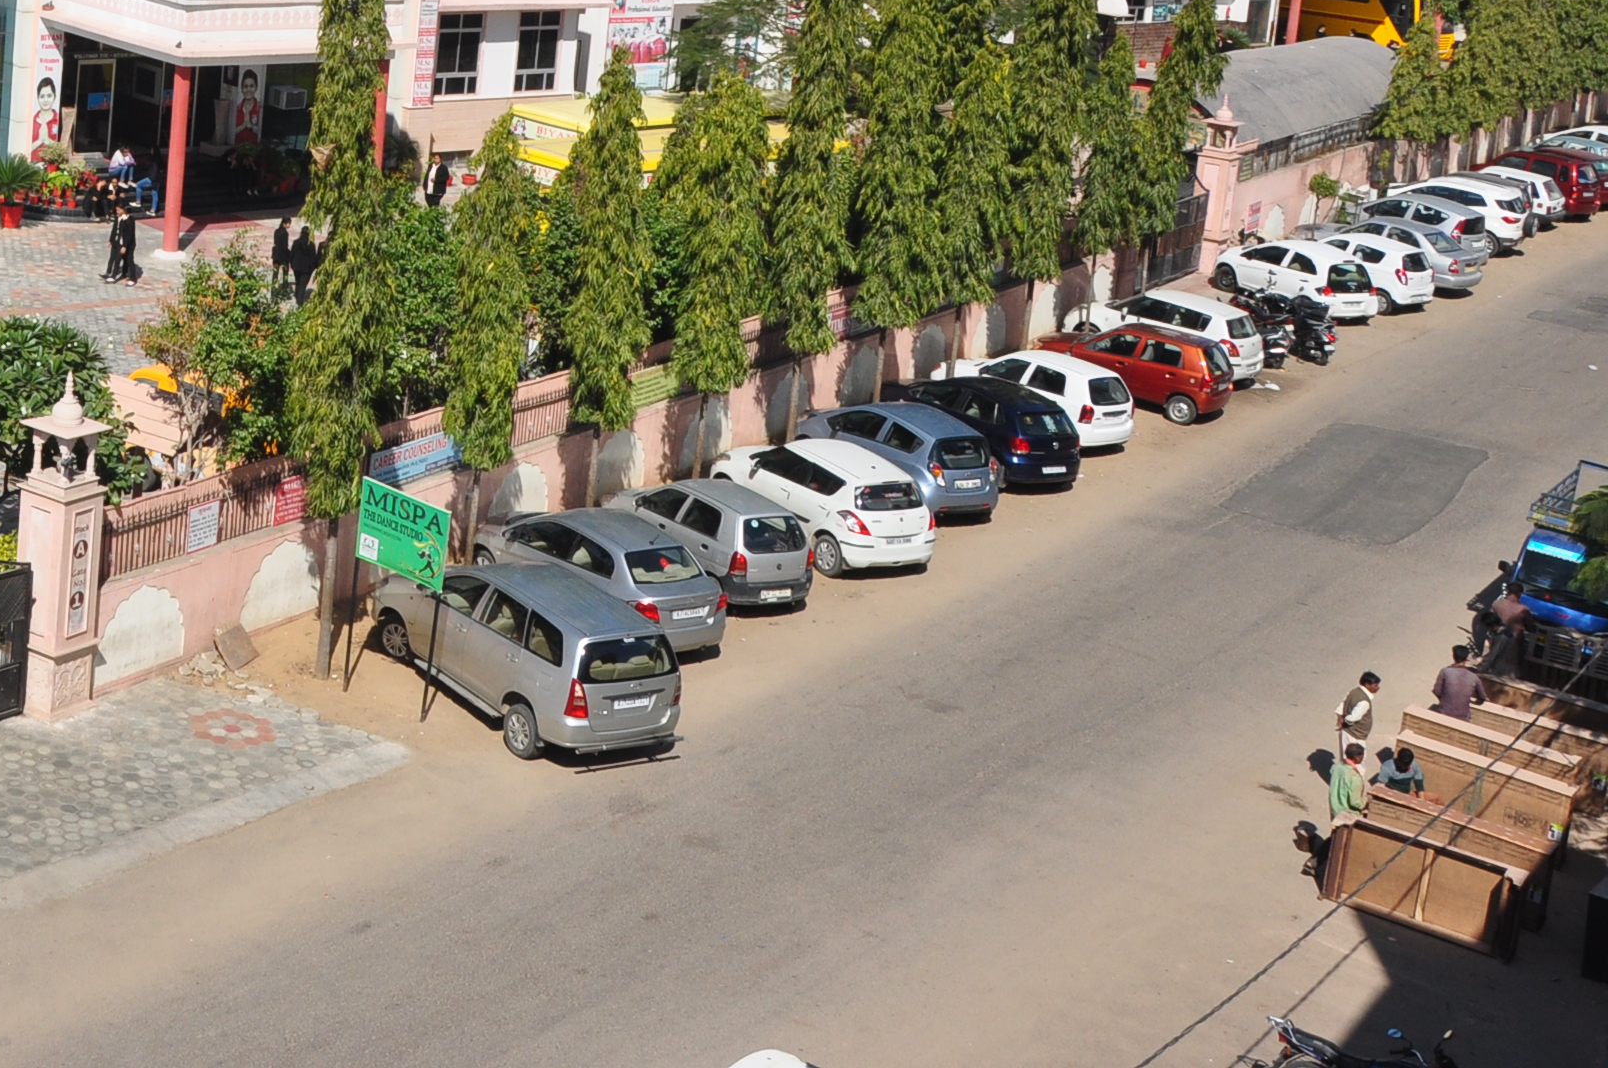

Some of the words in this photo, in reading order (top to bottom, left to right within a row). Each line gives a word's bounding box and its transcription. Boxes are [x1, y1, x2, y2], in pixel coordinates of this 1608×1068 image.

[40, 33, 63, 42] BIYANI
[373, 451, 403, 471] CAREER
[403, 436, 448, 461] COUNSELING
[364, 483, 444, 537] MISPA
[75, 523, 90, 535] Block
[363, 508, 376, 523] THE
[376, 512, 400, 533] DANCE
[400, 523, 424, 543] STUDIO
[76, 541, 85, 558] A
[72, 567, 87, 578] Gate
[72, 592, 81, 609] 1
